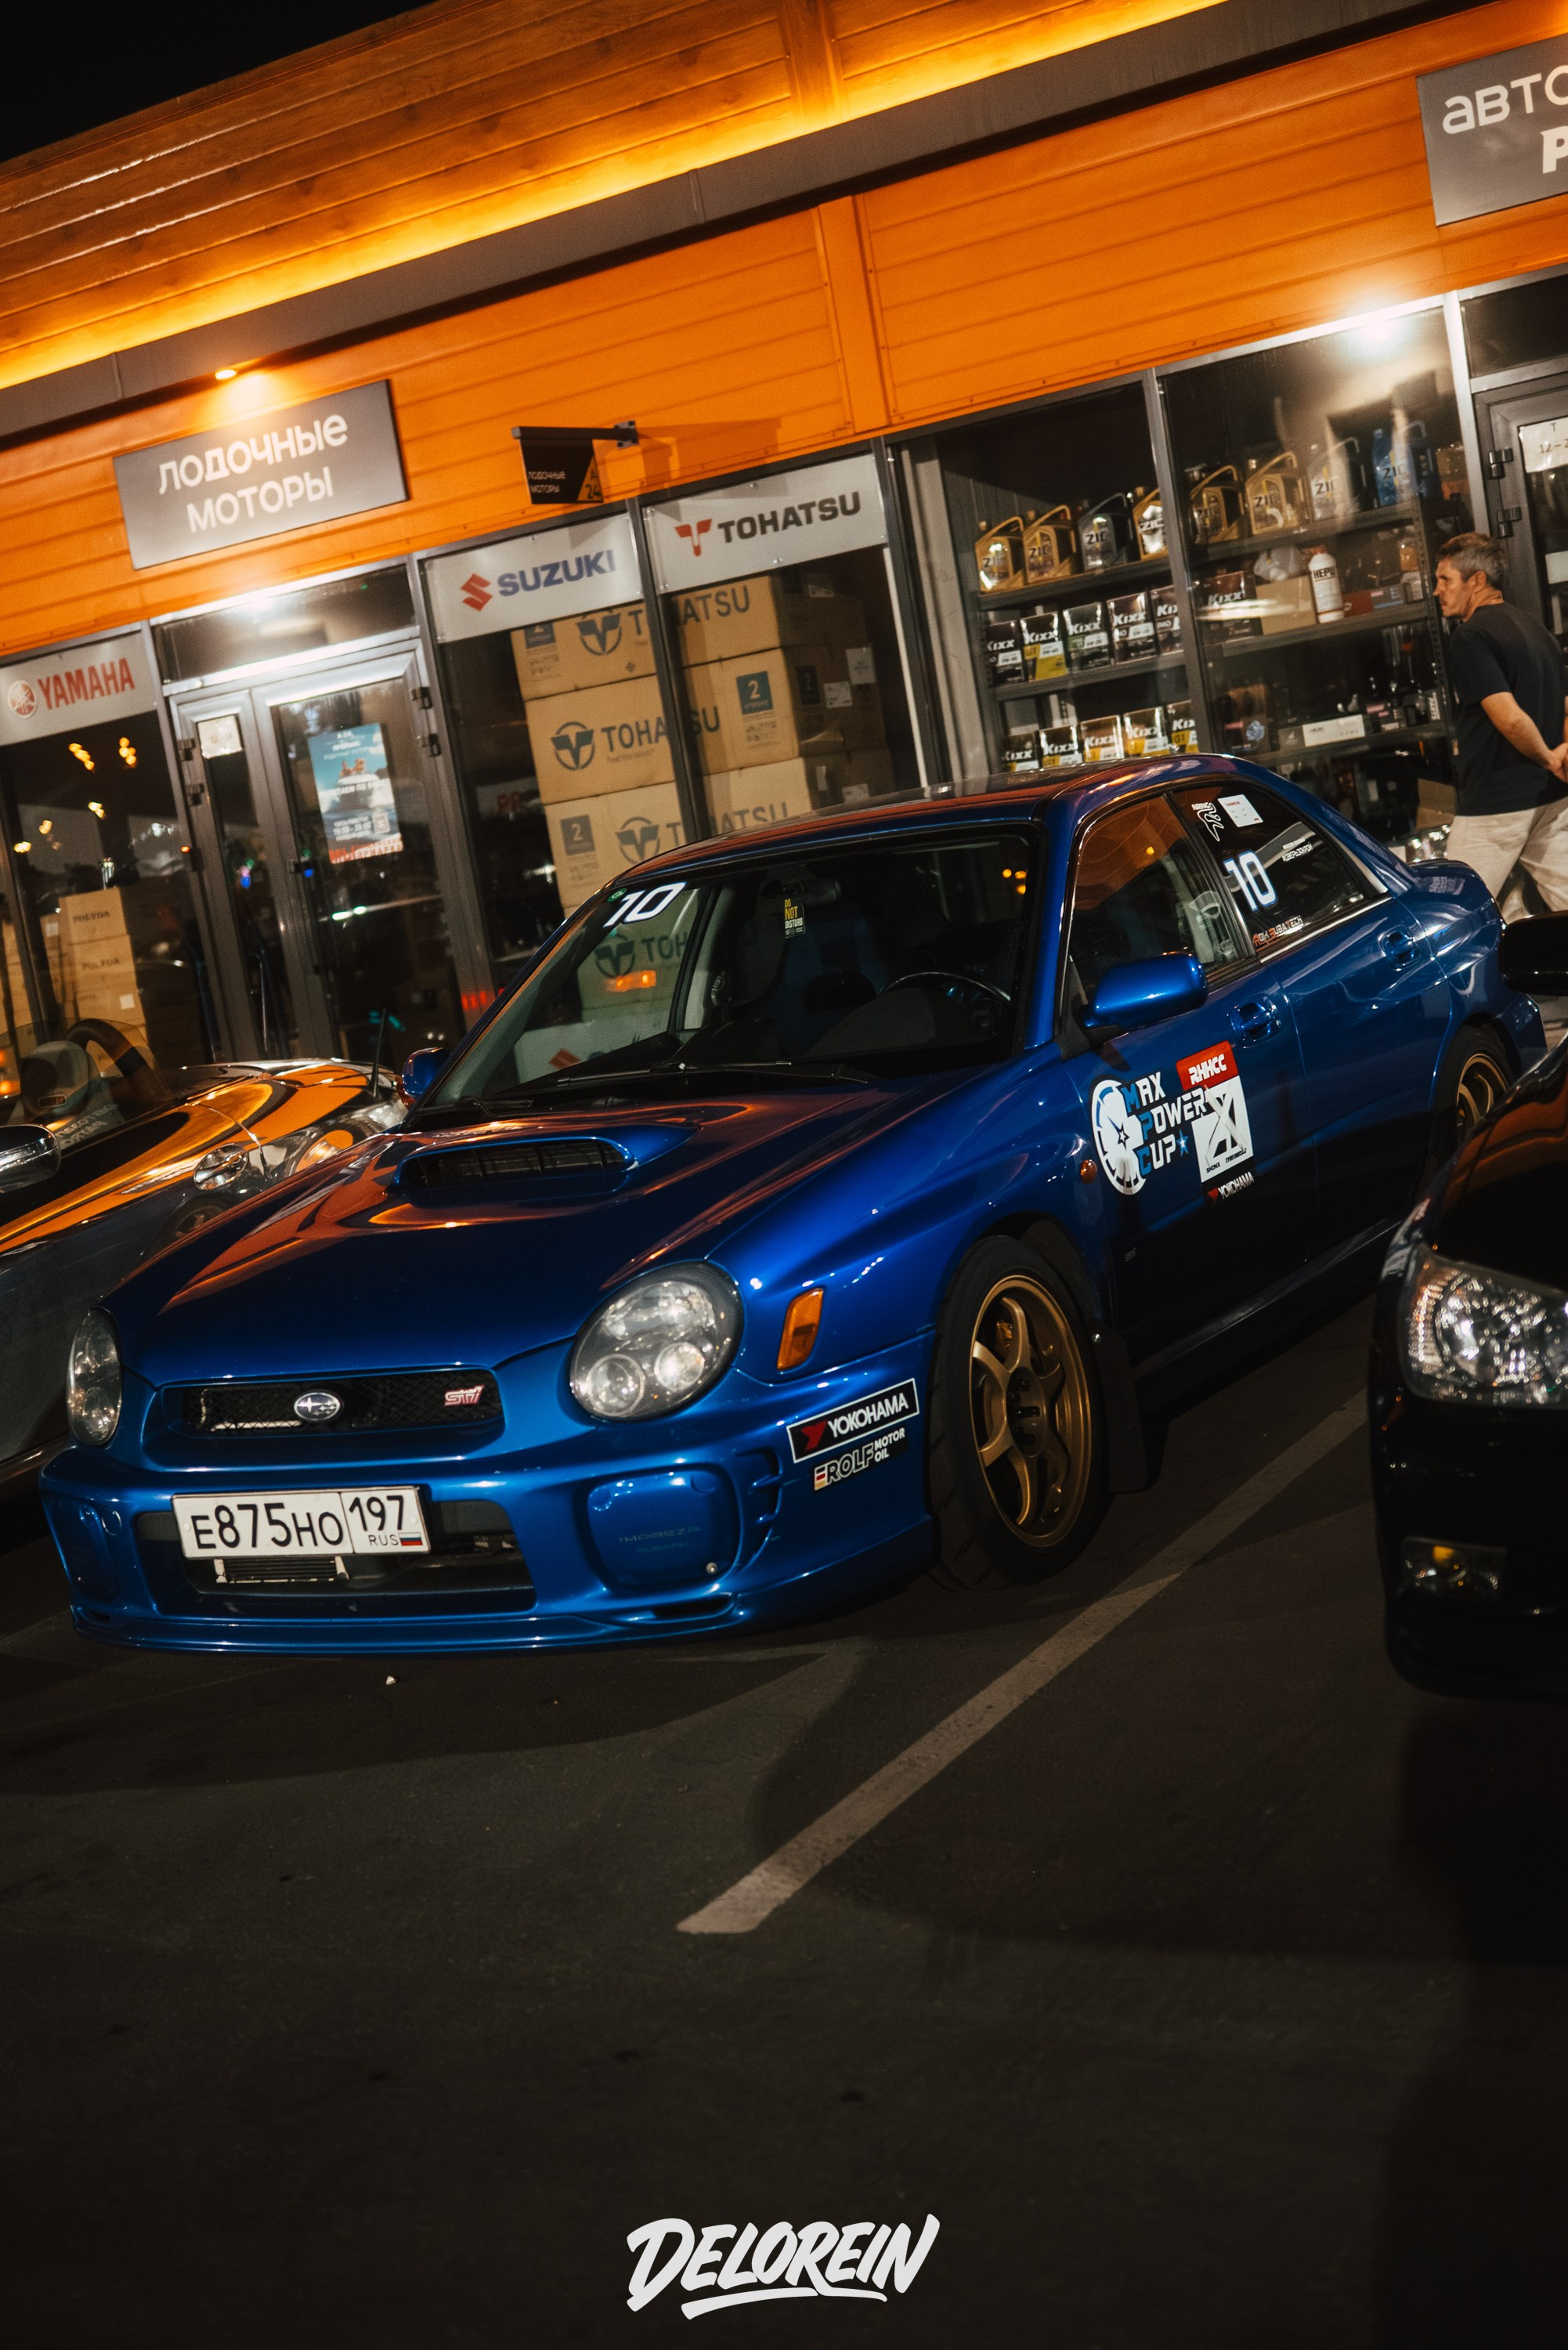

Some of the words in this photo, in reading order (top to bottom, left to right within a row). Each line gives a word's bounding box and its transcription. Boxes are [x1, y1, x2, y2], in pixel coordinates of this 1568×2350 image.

[186, 466, 334, 533] МОТОРЫ
[717, 491, 861, 543] TOHATSU
[1086, 531, 1107, 544] ZIC
[497, 549, 616, 598] SUZUKI
[1114, 611, 1146, 627] Kixx
[37, 656, 135, 710] YAMAHA
[748, 680, 761, 700] 2
[1223, 850, 1278, 912] 10
[602, 880, 688, 929] 10
[784, 898, 791, 908] DO
[784, 906, 798, 920] NOT
[785, 917, 804, 929] DISTURB
[1121, 1072, 1166, 1114] MAX
[1138, 1087, 1207, 1141] POWER
[1136, 1133, 1176, 1177] CUP
[1218, 1171, 1255, 1199] YOKOHAMA
[828, 1393, 909, 1438] YOKOHAMA
[826, 1443, 875, 1484] ROLF
[874, 1427, 905, 1451] MOTOR
[874, 1448, 890, 1462] OIL
[349, 1495, 404, 1532] 197
[368, 1533, 399, 1547] RUS
